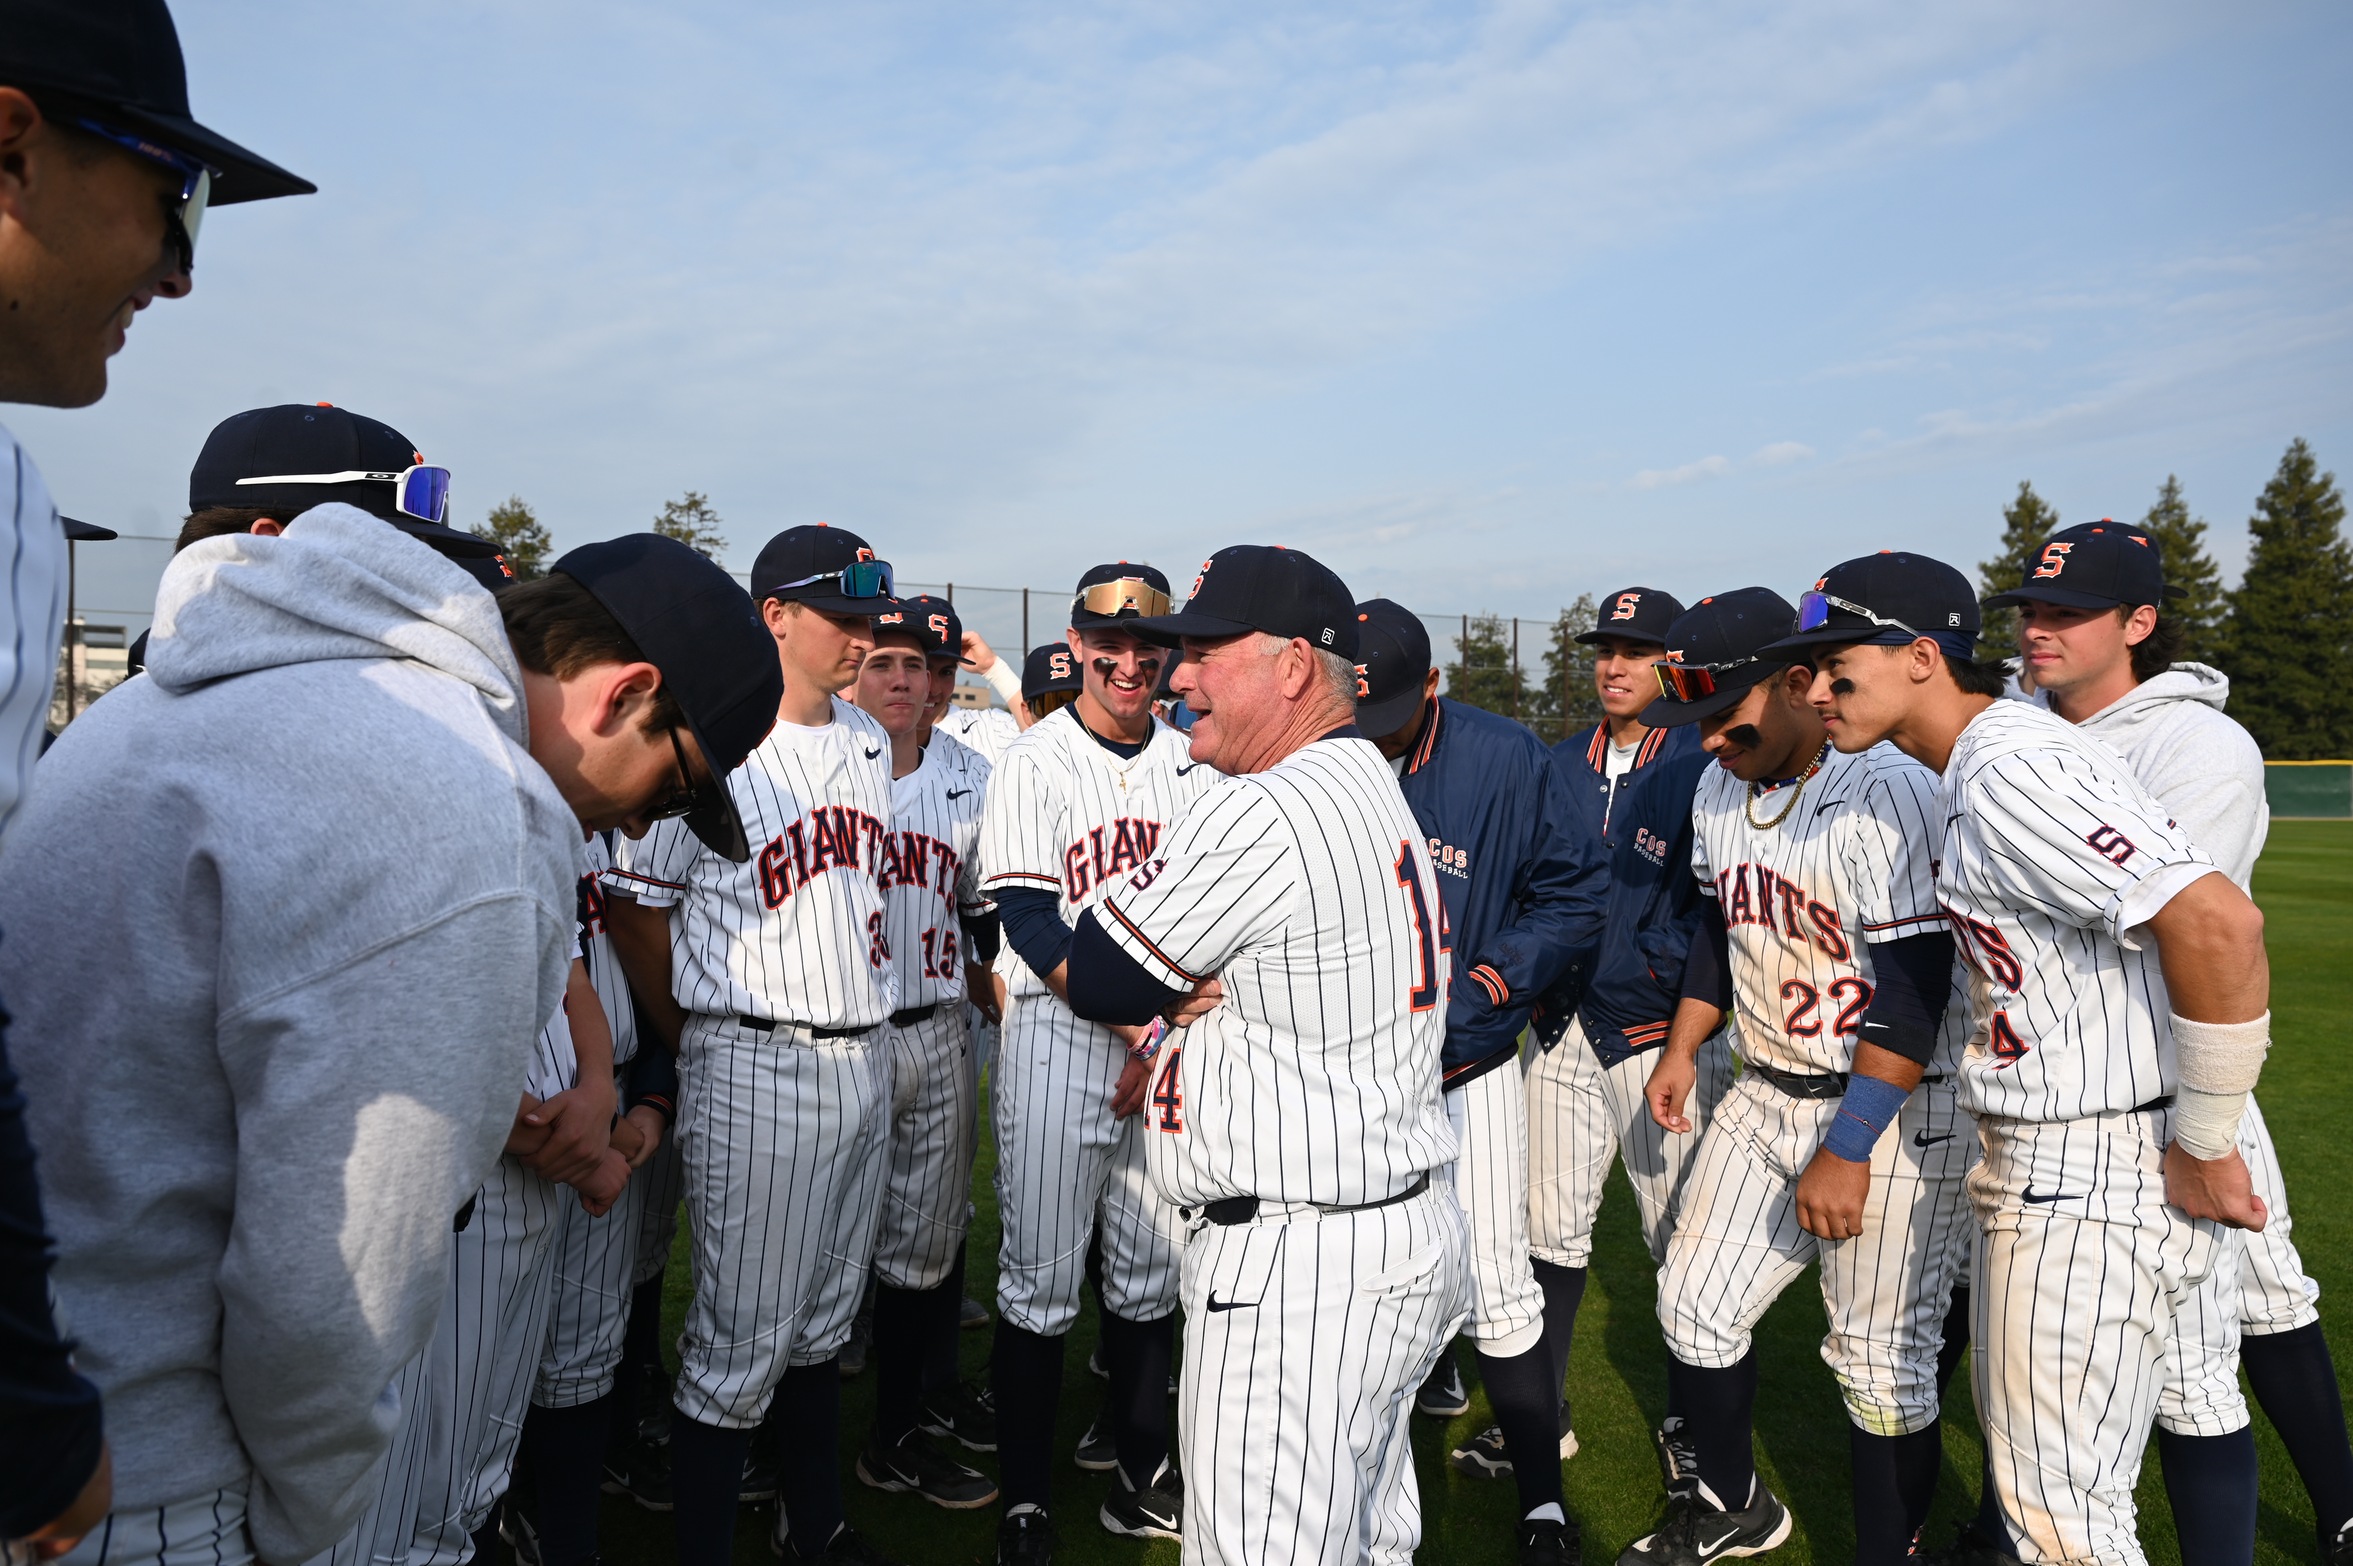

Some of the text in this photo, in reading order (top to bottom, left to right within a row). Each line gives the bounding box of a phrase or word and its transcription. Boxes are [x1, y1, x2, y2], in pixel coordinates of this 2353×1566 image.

[2032, 542, 2075, 579] S
[1610, 593, 1642, 621] S
[928, 613, 949, 644] S
[1050, 652, 1071, 680] S
[758, 805, 884, 910] GIANT
[1066, 816, 1166, 905] GIAN
[1429, 838, 1467, 868] COS
[1633, 842, 1664, 867] BASEBALL
[1636, 827, 1667, 857] COS
[2086, 823, 2137, 868] S
[1714, 862, 1851, 963] IANTS
[921, 927, 957, 980] 15
[1780, 976, 1877, 1039] 22
[1144, 1046, 1183, 1134] 4
